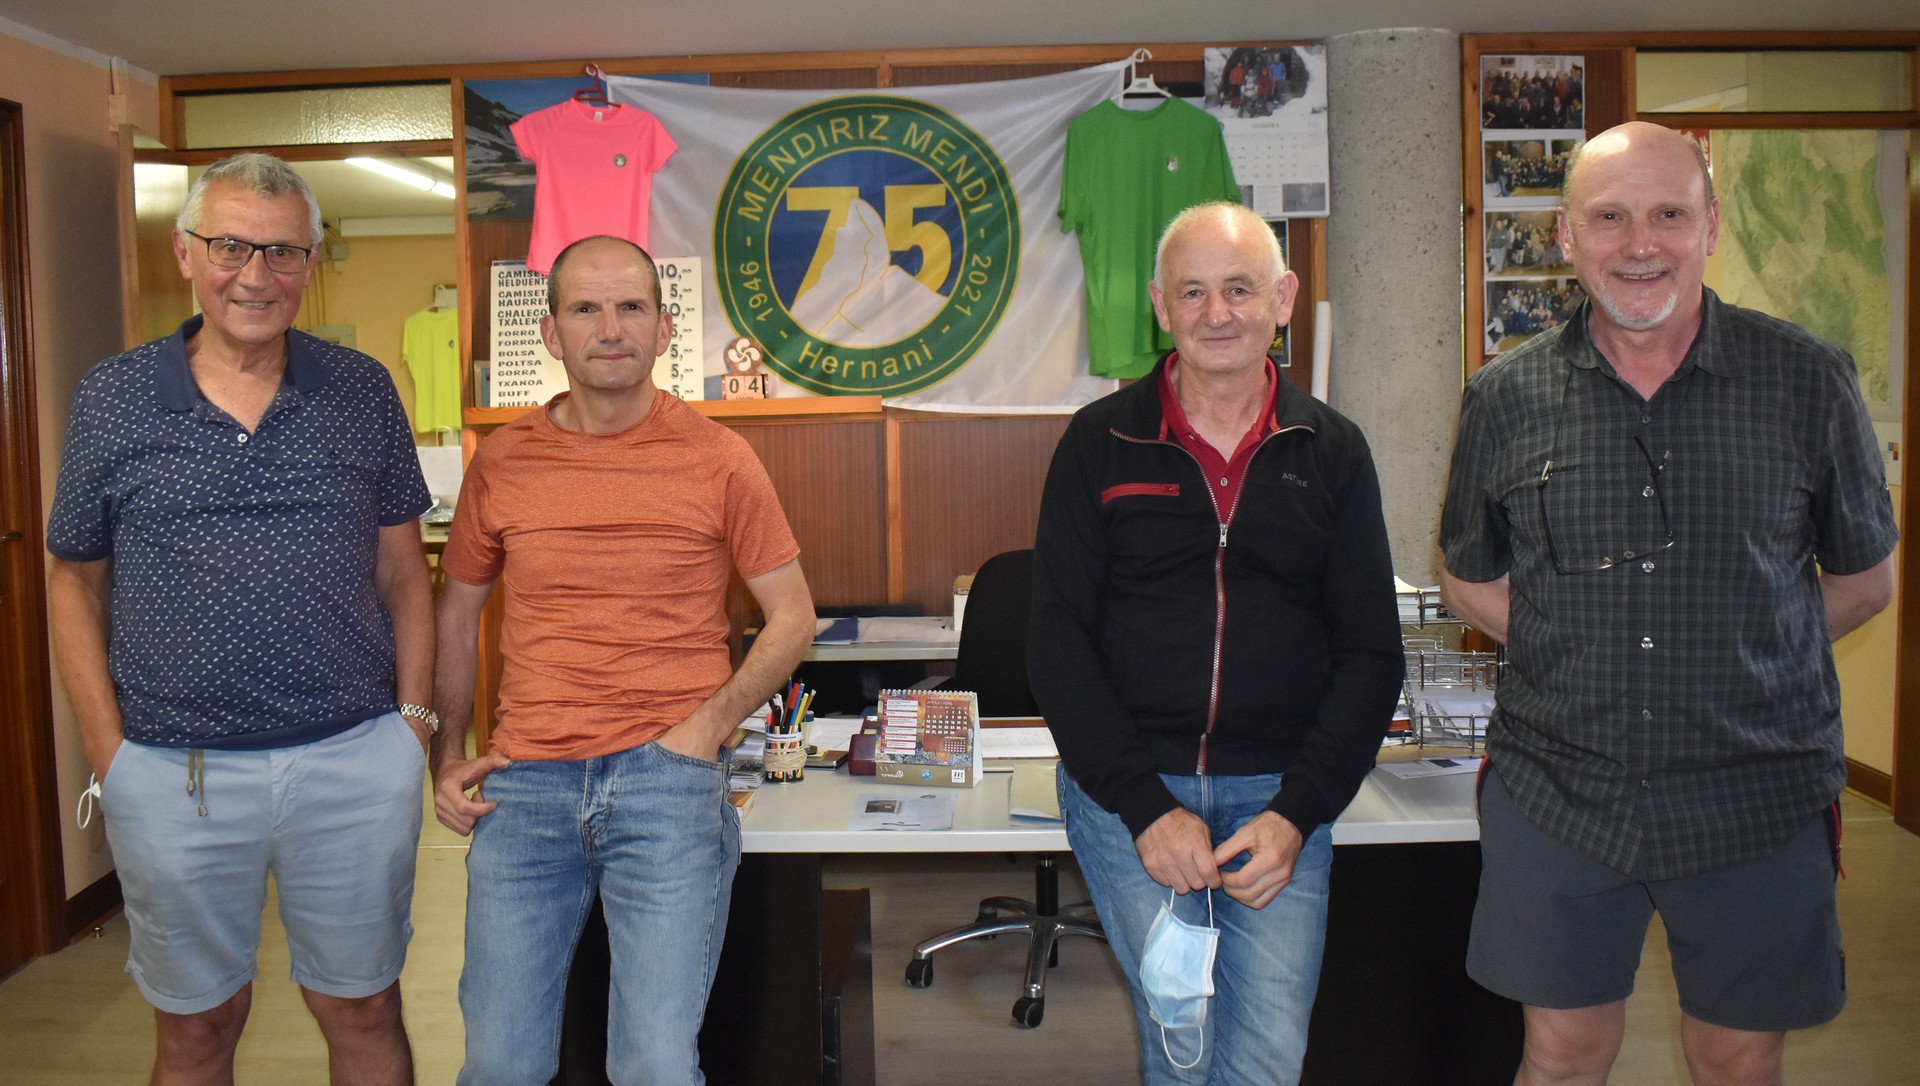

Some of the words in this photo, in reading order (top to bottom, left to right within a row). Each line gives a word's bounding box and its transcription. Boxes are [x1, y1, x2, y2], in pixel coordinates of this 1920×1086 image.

[737, 114, 889, 222] MENDIRIZ
[903, 120, 993, 215] MENDI
[786, 183, 952, 312] 75
[498, 289, 549, 298] CAMISET
[739, 260, 775, 322] 1946
[954, 252, 993, 318] 2021
[498, 309, 548, 318] CHALECO
[498, 317, 541, 326] TXALEK
[498, 339, 543, 347] FORROA
[798, 338, 934, 379] Hernani
[498, 369, 537, 377] GORRA
